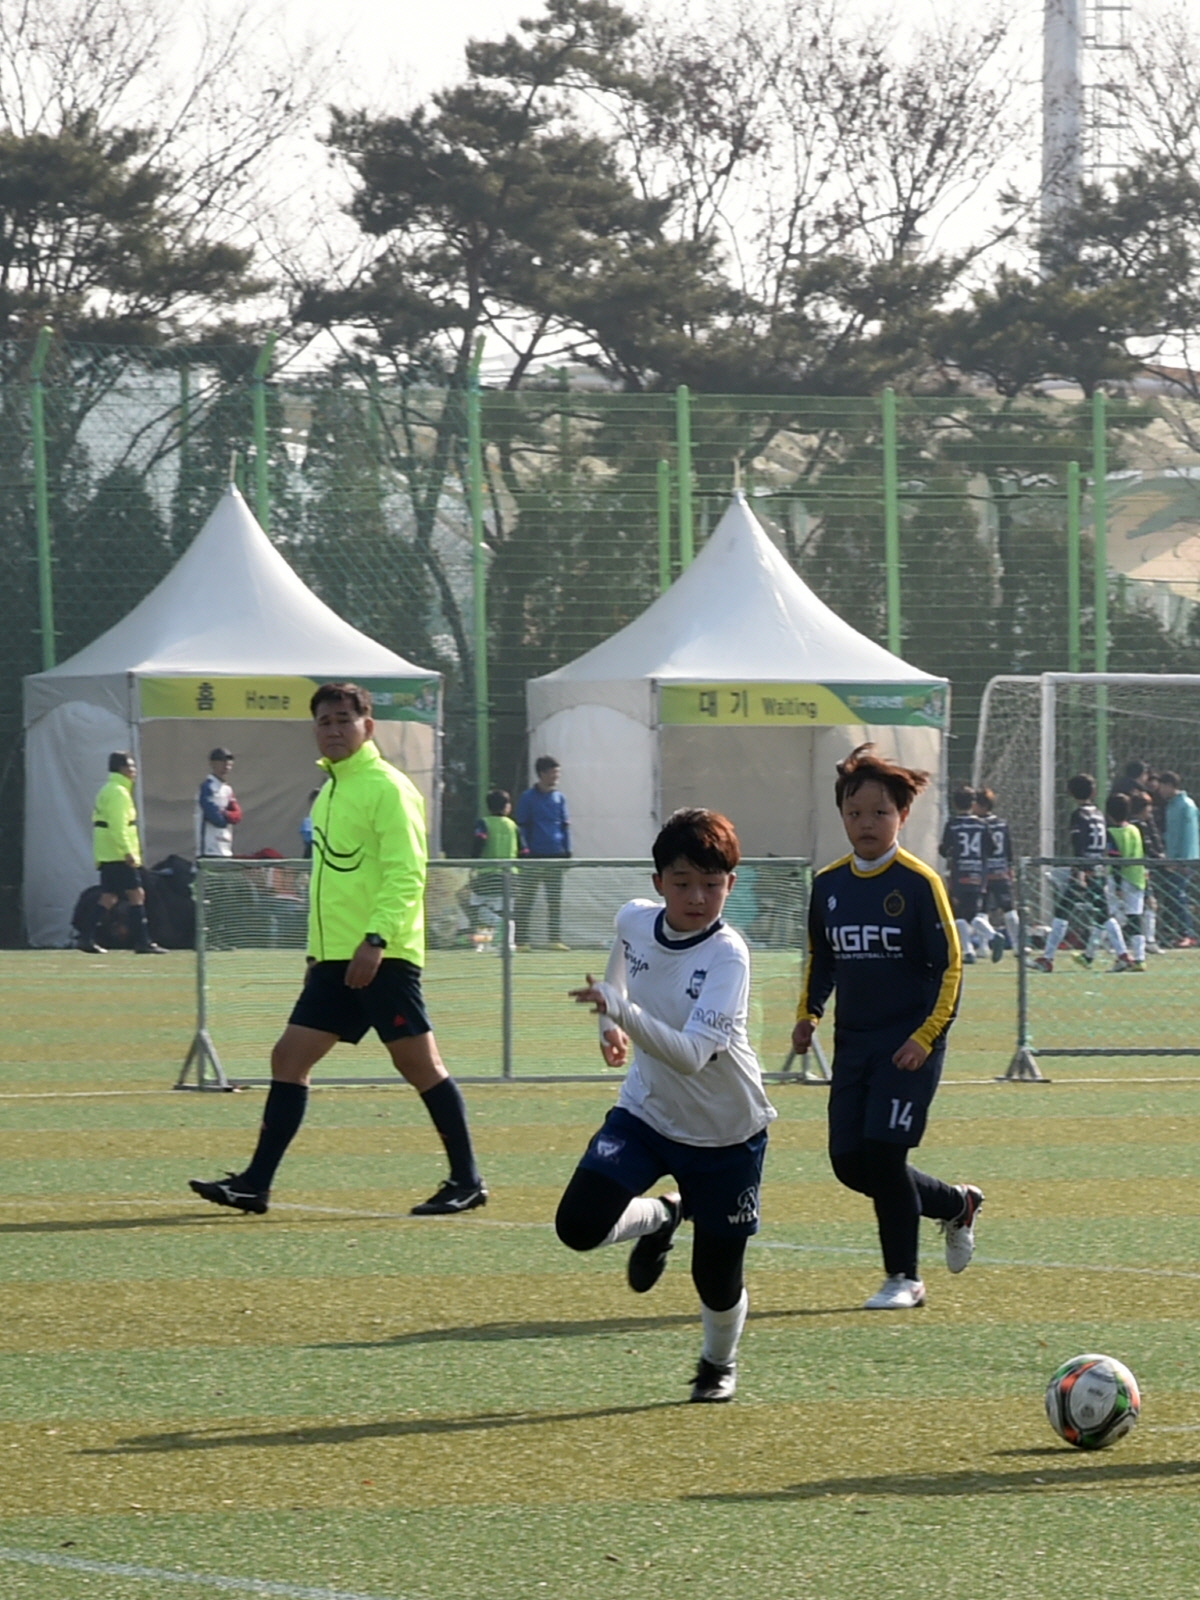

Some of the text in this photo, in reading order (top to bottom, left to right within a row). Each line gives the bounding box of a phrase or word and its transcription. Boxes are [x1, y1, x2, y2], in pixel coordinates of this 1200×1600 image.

[195, 682, 290, 711] 홈 Home
[762, 697, 818, 719] Waiting
[958, 832, 982, 857] 34
[889, 1098, 913, 1132] 14
